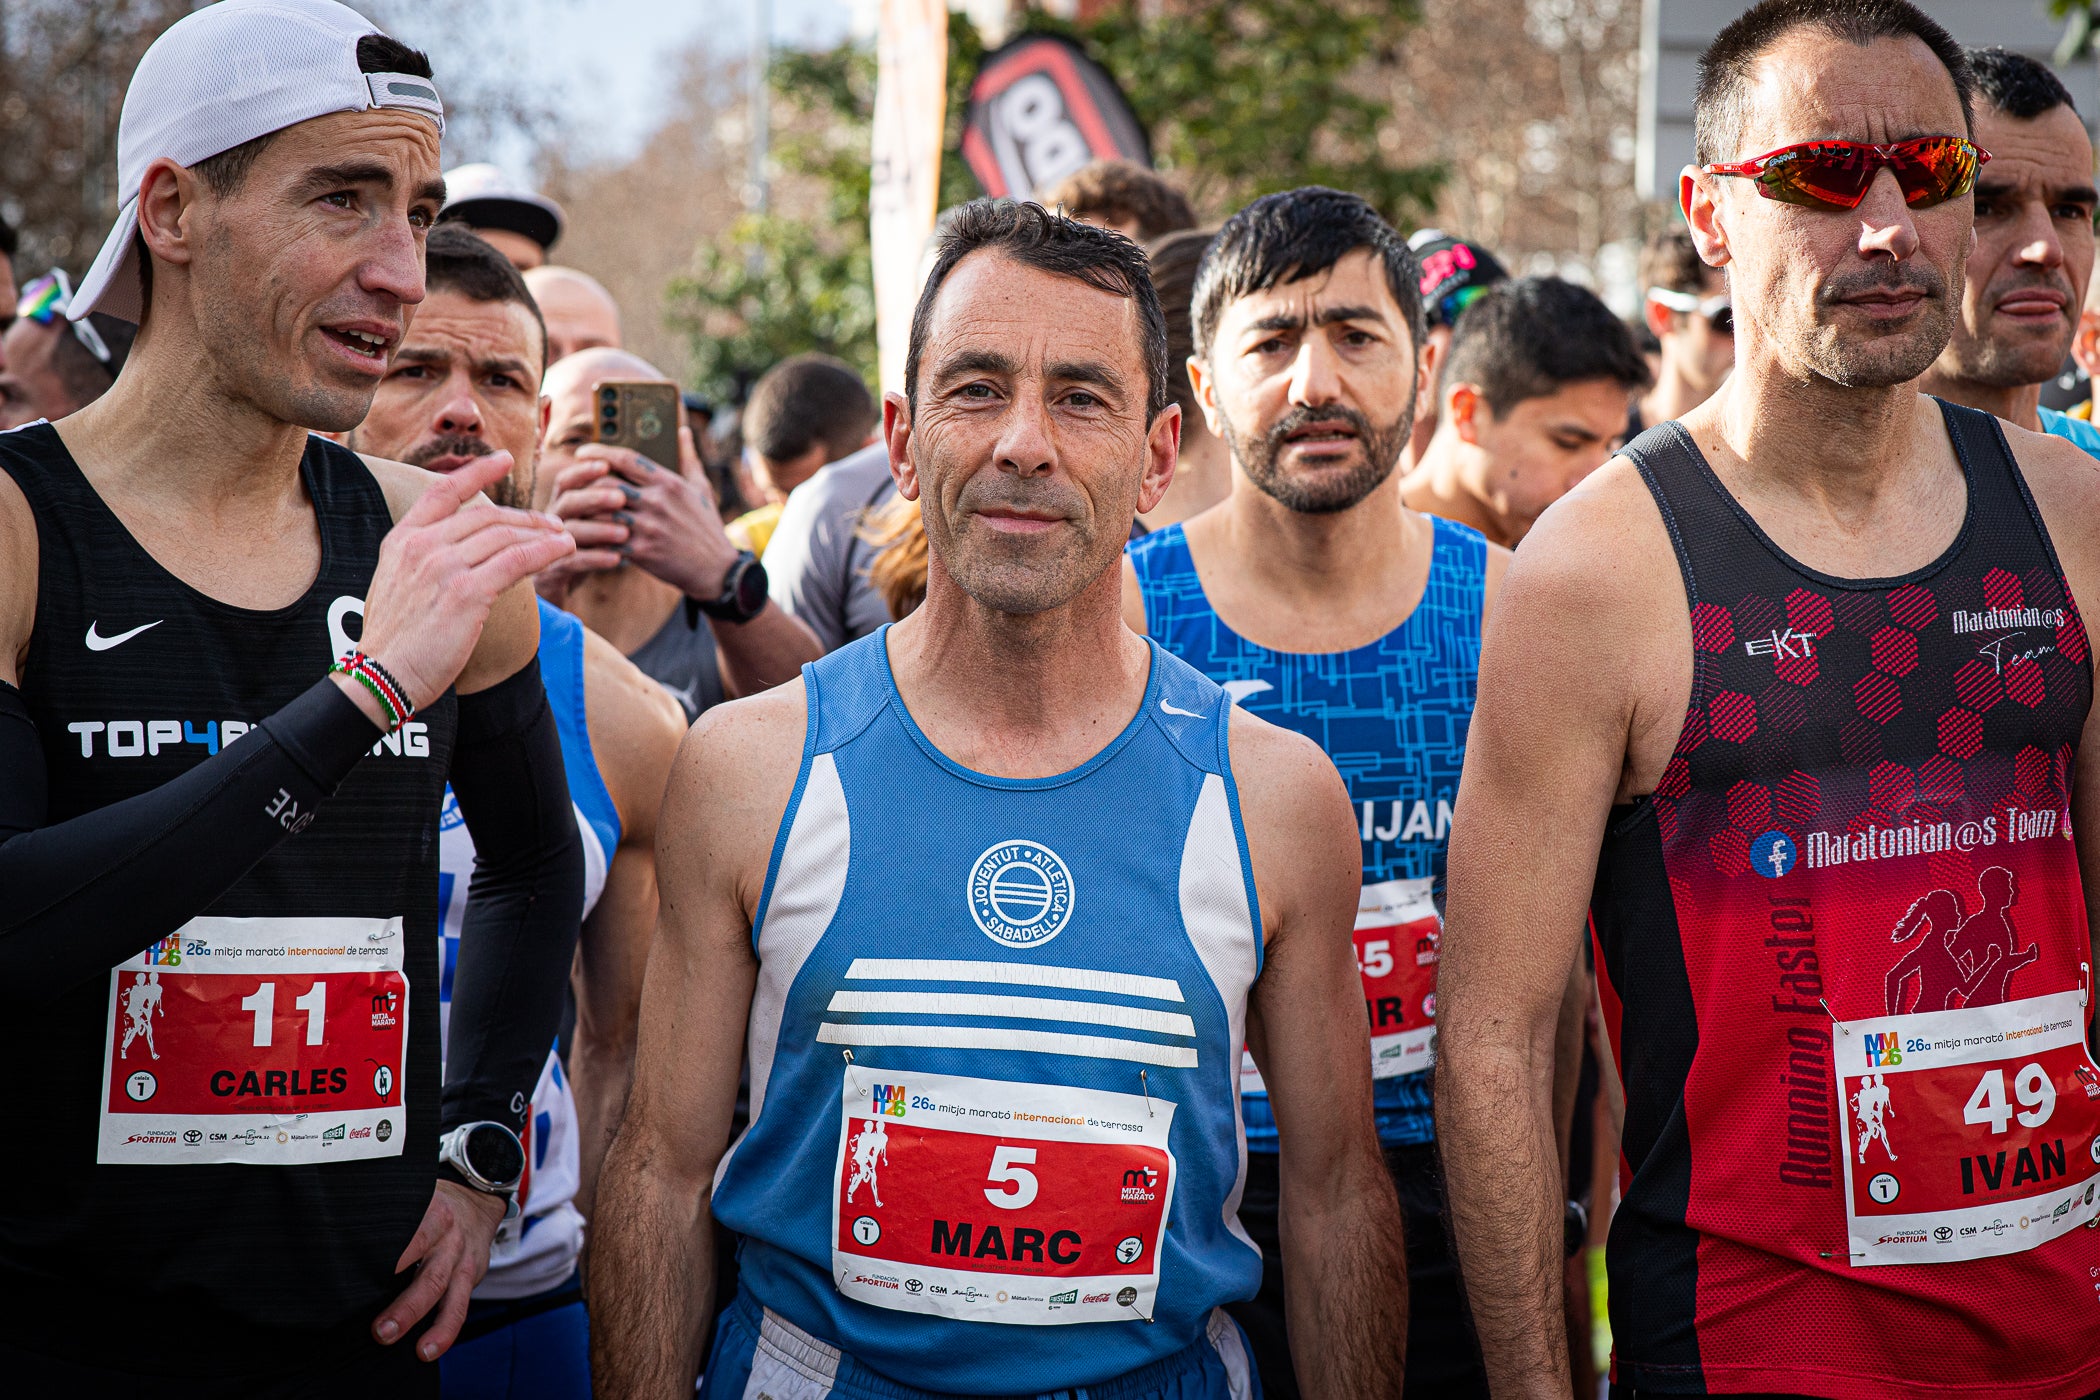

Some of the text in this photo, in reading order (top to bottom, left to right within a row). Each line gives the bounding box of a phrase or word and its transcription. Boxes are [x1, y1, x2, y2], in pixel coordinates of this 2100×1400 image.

[1979, 631, 2055, 675] Team
[1363, 800, 1453, 841] IJAN
[2006, 807, 2057, 844] Team
[975, 847, 1019, 906] JOVENTUT
[1032, 852, 1067, 912] ATLETICA
[986, 917, 1057, 941] SABADELL
[186, 942, 211, 956] 26a
[214, 947, 242, 959] mitja
[246, 946, 285, 957] marató
[288, 946, 346, 957] internacional
[347, 946, 357, 955] de
[1354, 940, 1394, 978] 5
[242, 981, 326, 1047] 11
[1764, 896, 1833, 1189] Running Faster
[1906, 1038, 1931, 1053] 26a
[1934, 1039, 1961, 1050] mitja
[1964, 1034, 2004, 1047] marató
[2005, 1024, 2043, 1041] internacional
[2050, 1019, 2072, 1031] terrassa
[137, 1082, 144, 1096] 1
[210, 1067, 348, 1096] CARLES
[912, 1096, 1143, 1132] 26a mitja marató internacional de terrassa
[1963, 1062, 2057, 1135] 49
[121, 1134, 177, 1145] SPORTIUM
[983, 1145, 1039, 1210] 5
[1960, 1138, 2066, 1195] IVAN
[1121, 1192, 1155, 1200] MARATÓ
[1122, 1187, 1145, 1195] MITJA
[1880, 1185, 1887, 1198] 1
[863, 1227, 869, 1240] 1
[930, 1219, 1082, 1265] MARC
[1872, 1235, 1927, 1246] SPORTIUM
[1960, 1226, 1977, 1235] CSM
[851, 1275, 899, 1290] SPORTIUM
[872, 1273, 899, 1282] FUNDACIÓN
[930, 1286, 947, 1294] CSM
